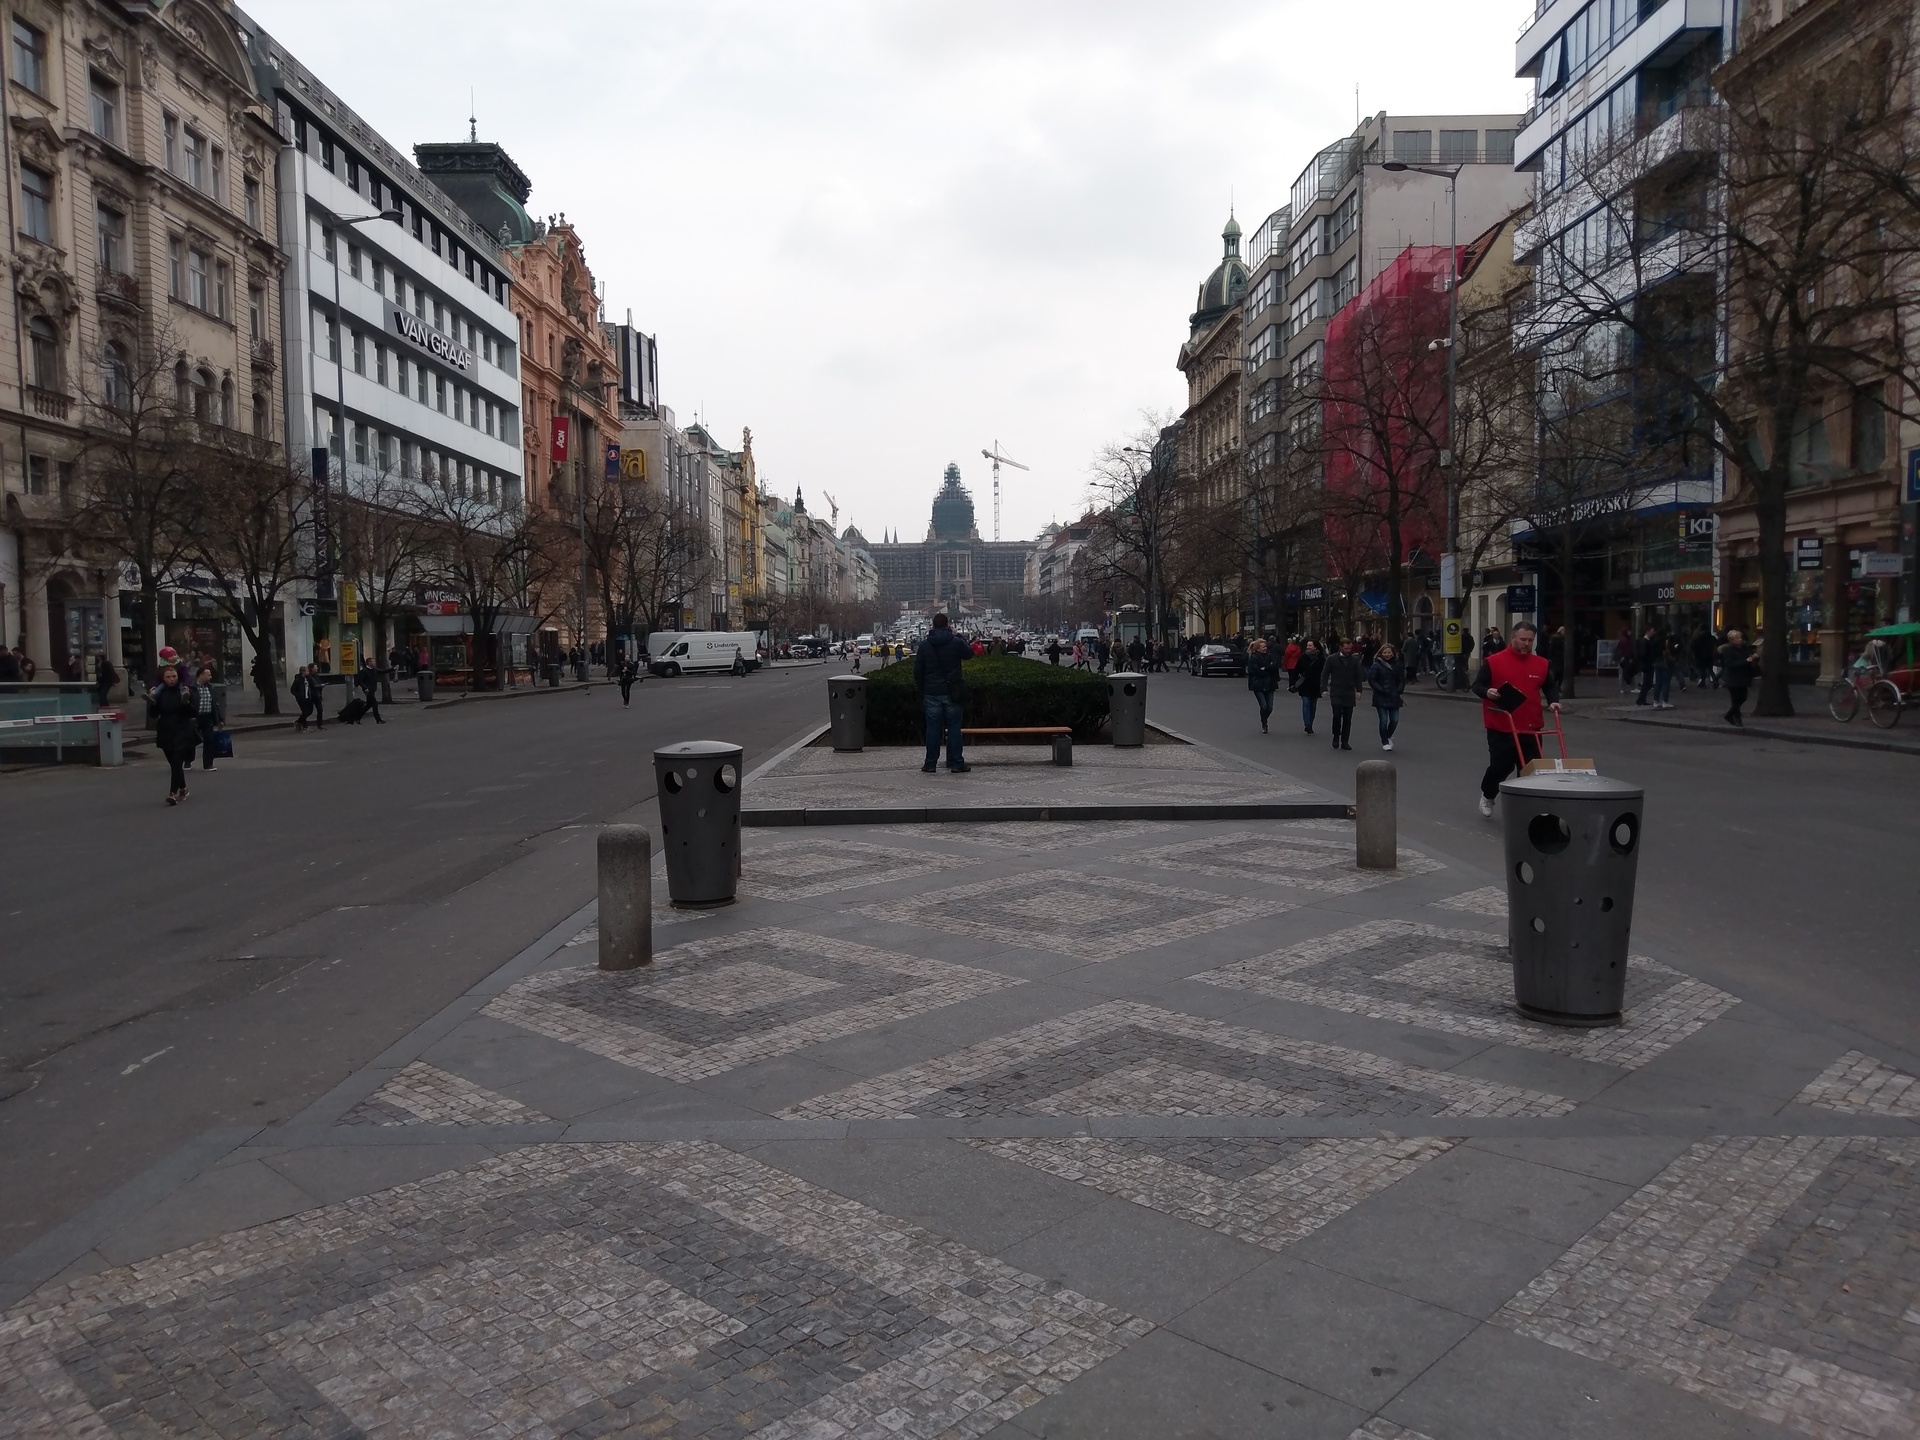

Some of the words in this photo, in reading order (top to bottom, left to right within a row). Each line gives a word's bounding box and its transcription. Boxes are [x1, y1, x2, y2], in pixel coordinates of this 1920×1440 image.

[399, 311, 429, 347] VAN
[430, 332, 472, 370] GRAAF
[1304, 587, 1322, 600] PRAGUE
